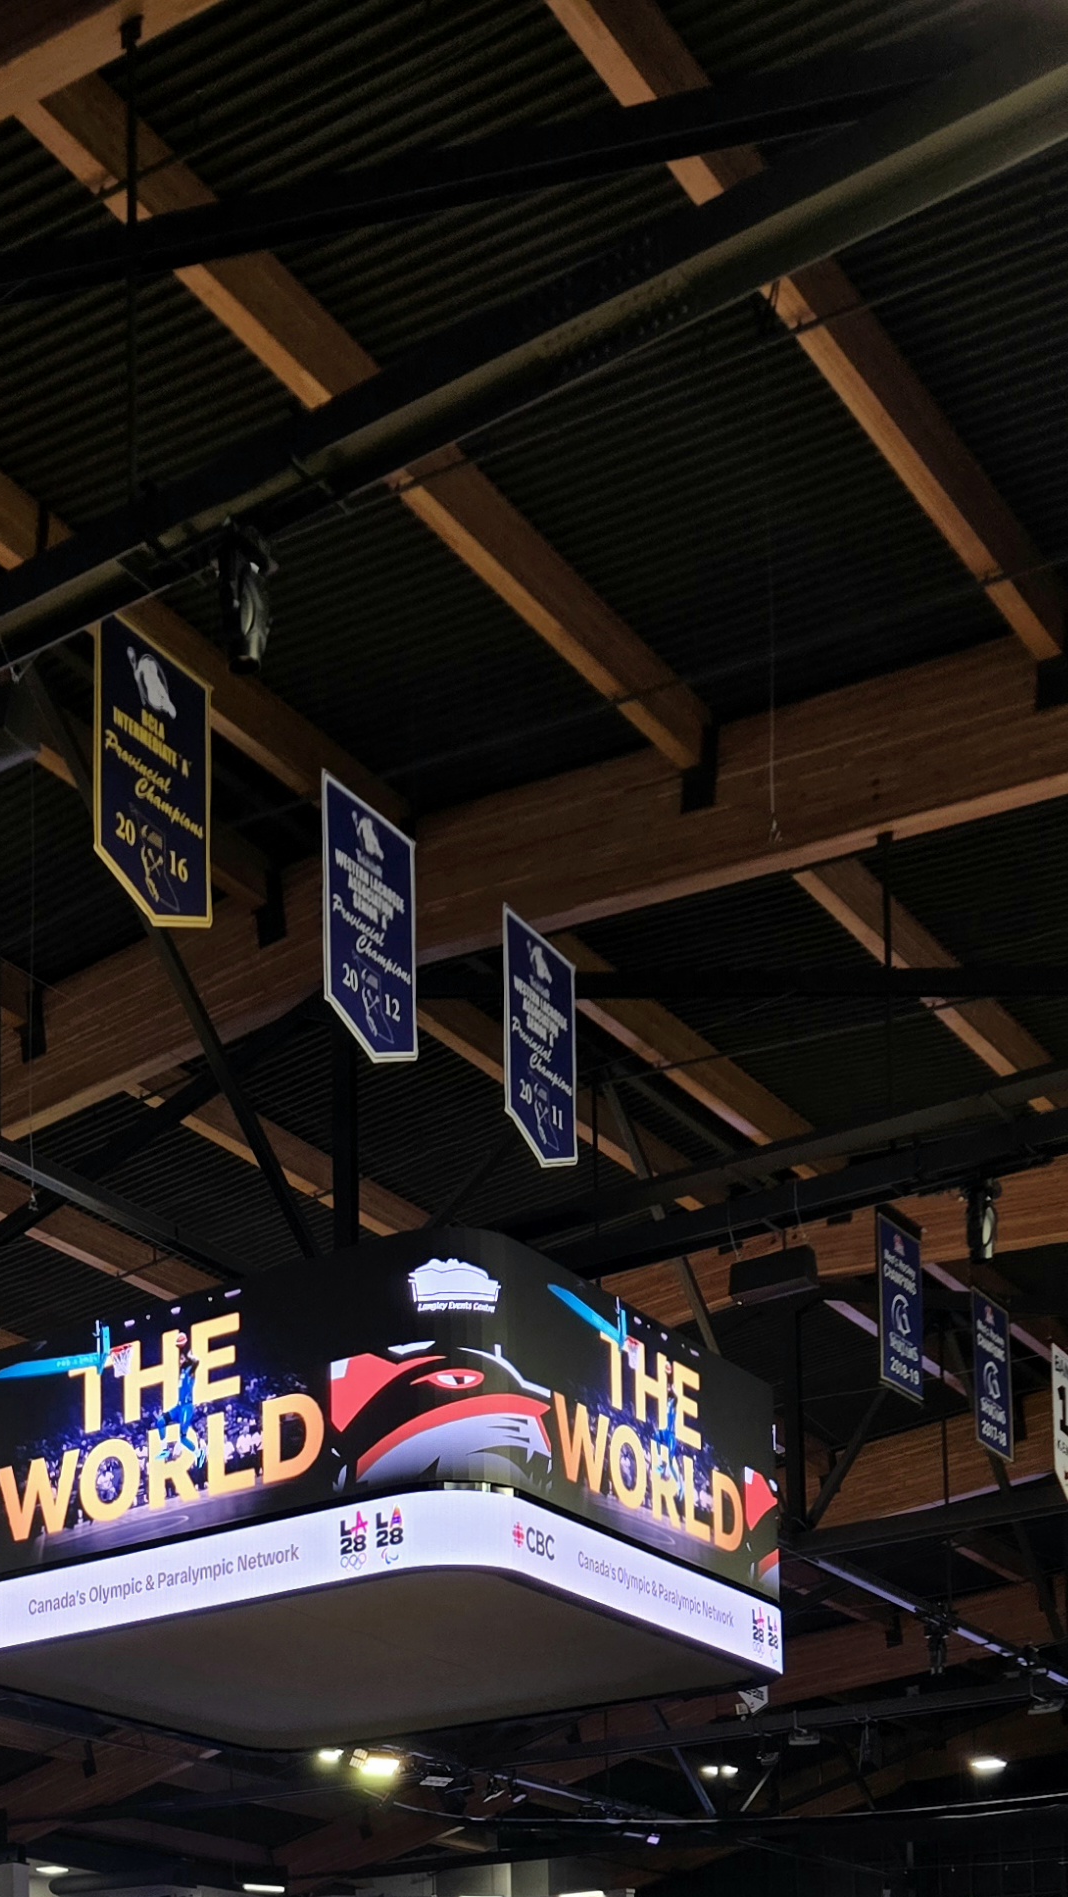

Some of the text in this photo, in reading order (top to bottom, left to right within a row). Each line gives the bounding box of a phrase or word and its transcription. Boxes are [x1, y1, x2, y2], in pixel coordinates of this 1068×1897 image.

[104, 729, 172, 794] Provincial
[135, 777, 204, 839] Champions
[115, 811, 136, 846] 20
[170, 850, 188, 882] 16
[332, 893, 385, 947] Provincial
[342, 962, 358, 992] 20
[355, 934, 411, 985] Champions
[384, 993, 400, 1022] 12
[512, 1016, 552, 1063] Provincial
[519, 1078, 532, 1105] 20
[529, 1052, 572, 1096] Champions
[552, 1105, 563, 1130] 11
[417, 1301, 496, 1313] Langley Events Centre
[68, 1311, 240, 1434] THE
[599, 1331, 701, 1451] THE
[553, 1390, 744, 1551] WORLD
[340, 1510, 368, 1537] LA
[376, 1504, 403, 1529] LA
[340, 1534, 367, 1555] 28
[376, 1527, 404, 1548] 28
[28, 1588, 86, 1616] Canada's
[89, 1577, 143, 1606] Olympic
[145, 1576, 155, 1591] &
[157, 1558, 234, 1590] Paralympic
[237, 1543, 300, 1572] Network
[526, 1527, 734, 1627] CBC Canada's Olympic & Paralympic Network
[752, 1625, 764, 1643] 28
